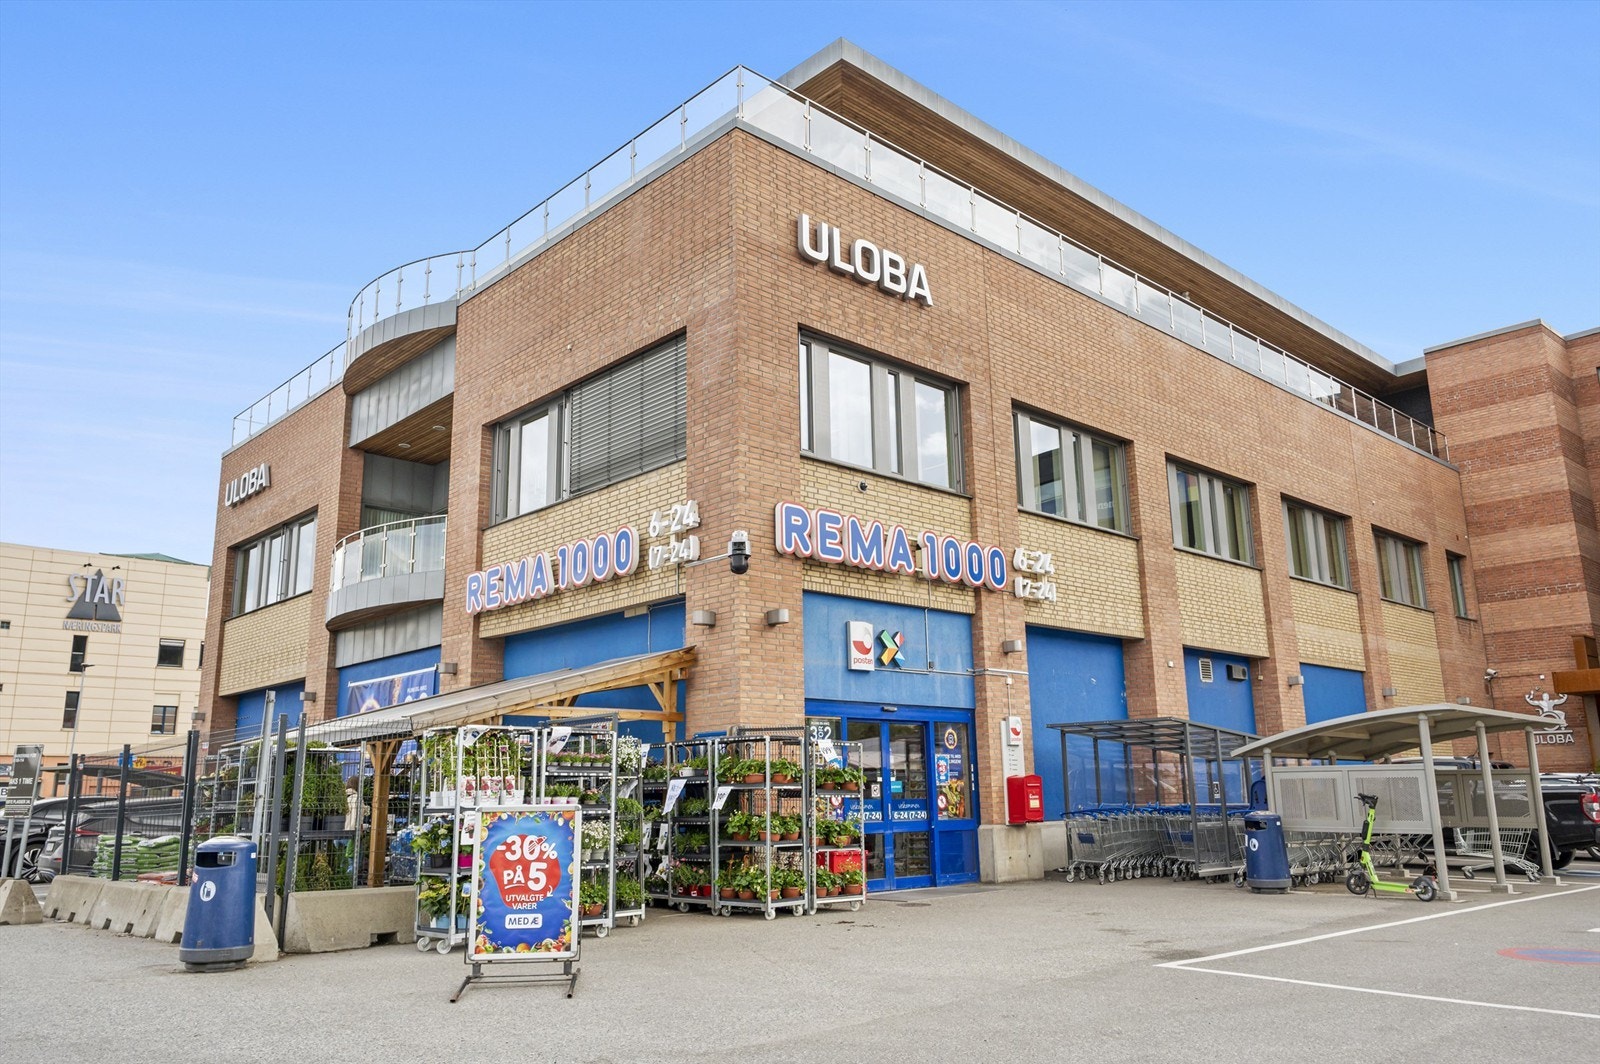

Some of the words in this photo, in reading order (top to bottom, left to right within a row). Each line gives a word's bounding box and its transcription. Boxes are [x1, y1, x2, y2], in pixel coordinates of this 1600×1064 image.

[798, 213, 933, 307] ULOBA
[225, 463, 271, 507] ULOBA
[649, 500, 700, 537] 6-24
[649, 535, 700, 570] (7-24)
[775, 502, 916, 575] REMA
[917, 530, 1008, 592] 1000
[465, 552, 555, 614] REMA
[556, 525, 640, 590] 1000
[66, 573, 125, 606] STAR
[853, 657, 874, 665] posten
[810, 725, 819, 742] 3
[893, 811, 908, 820] 6-24
[909, 811, 928, 820] (7-24)
[496, 835, 558, 861] -30%
[503, 865, 525, 885] PÅ
[527, 862, 548, 891] 5
[505, 894, 544, 902] UTVALGTE
[512, 902, 538, 910] VARER
[508, 917, 530, 926] MED
[530, 917, 540, 925] Æ
